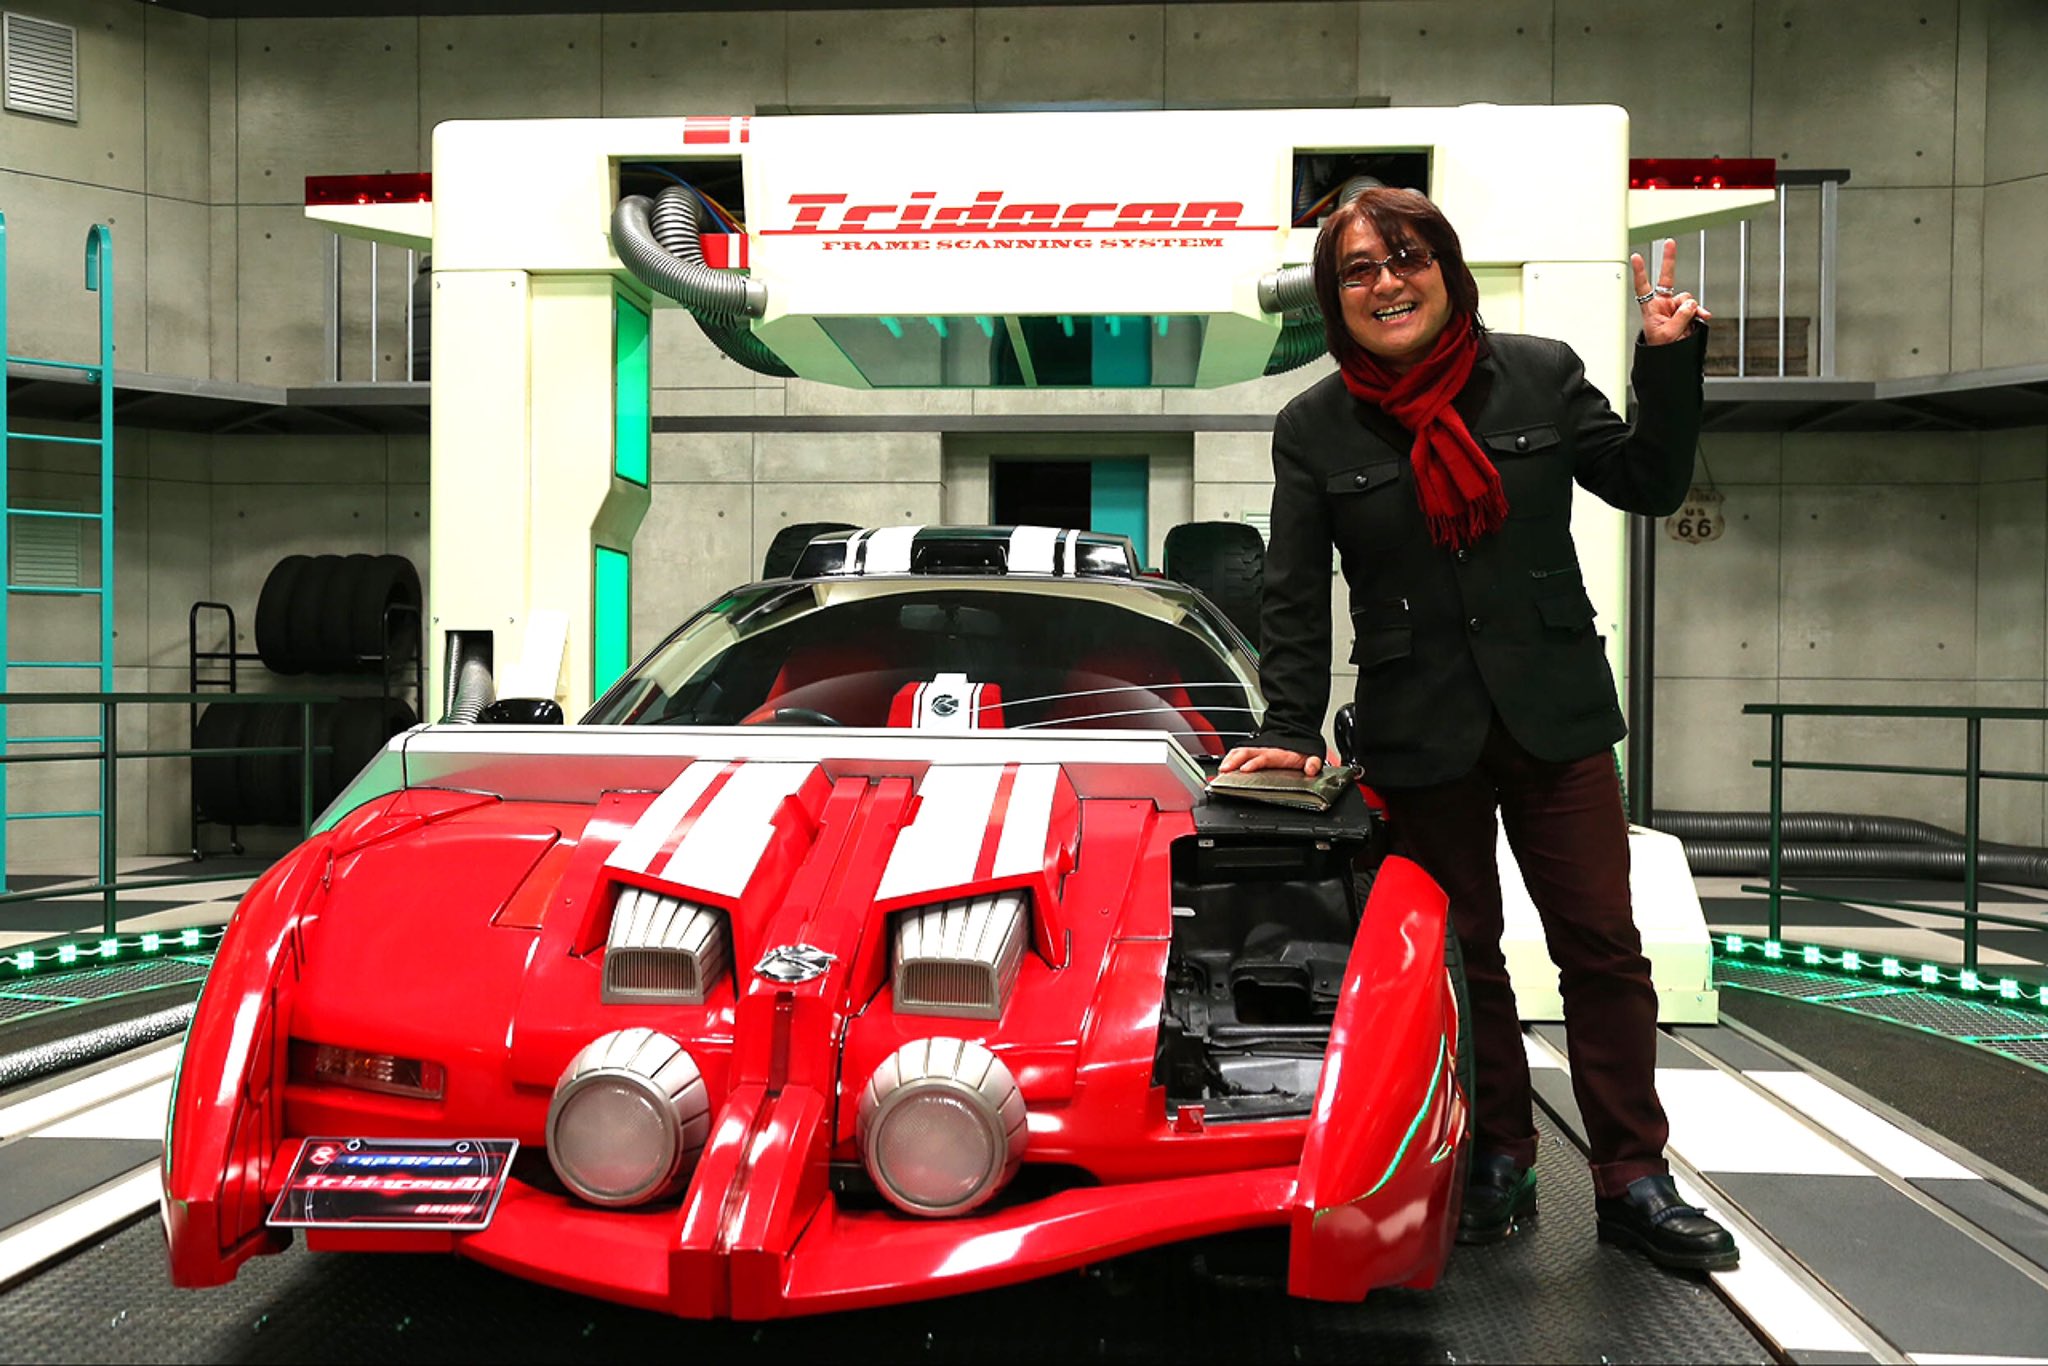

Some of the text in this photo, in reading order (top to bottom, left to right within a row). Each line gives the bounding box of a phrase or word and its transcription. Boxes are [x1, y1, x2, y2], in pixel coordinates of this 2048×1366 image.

[788, 191, 1244, 233] Tridoron
[822, 237, 1223, 250] FRAME SCANNING SYSTEM
[1678, 518, 1712, 537] 66
